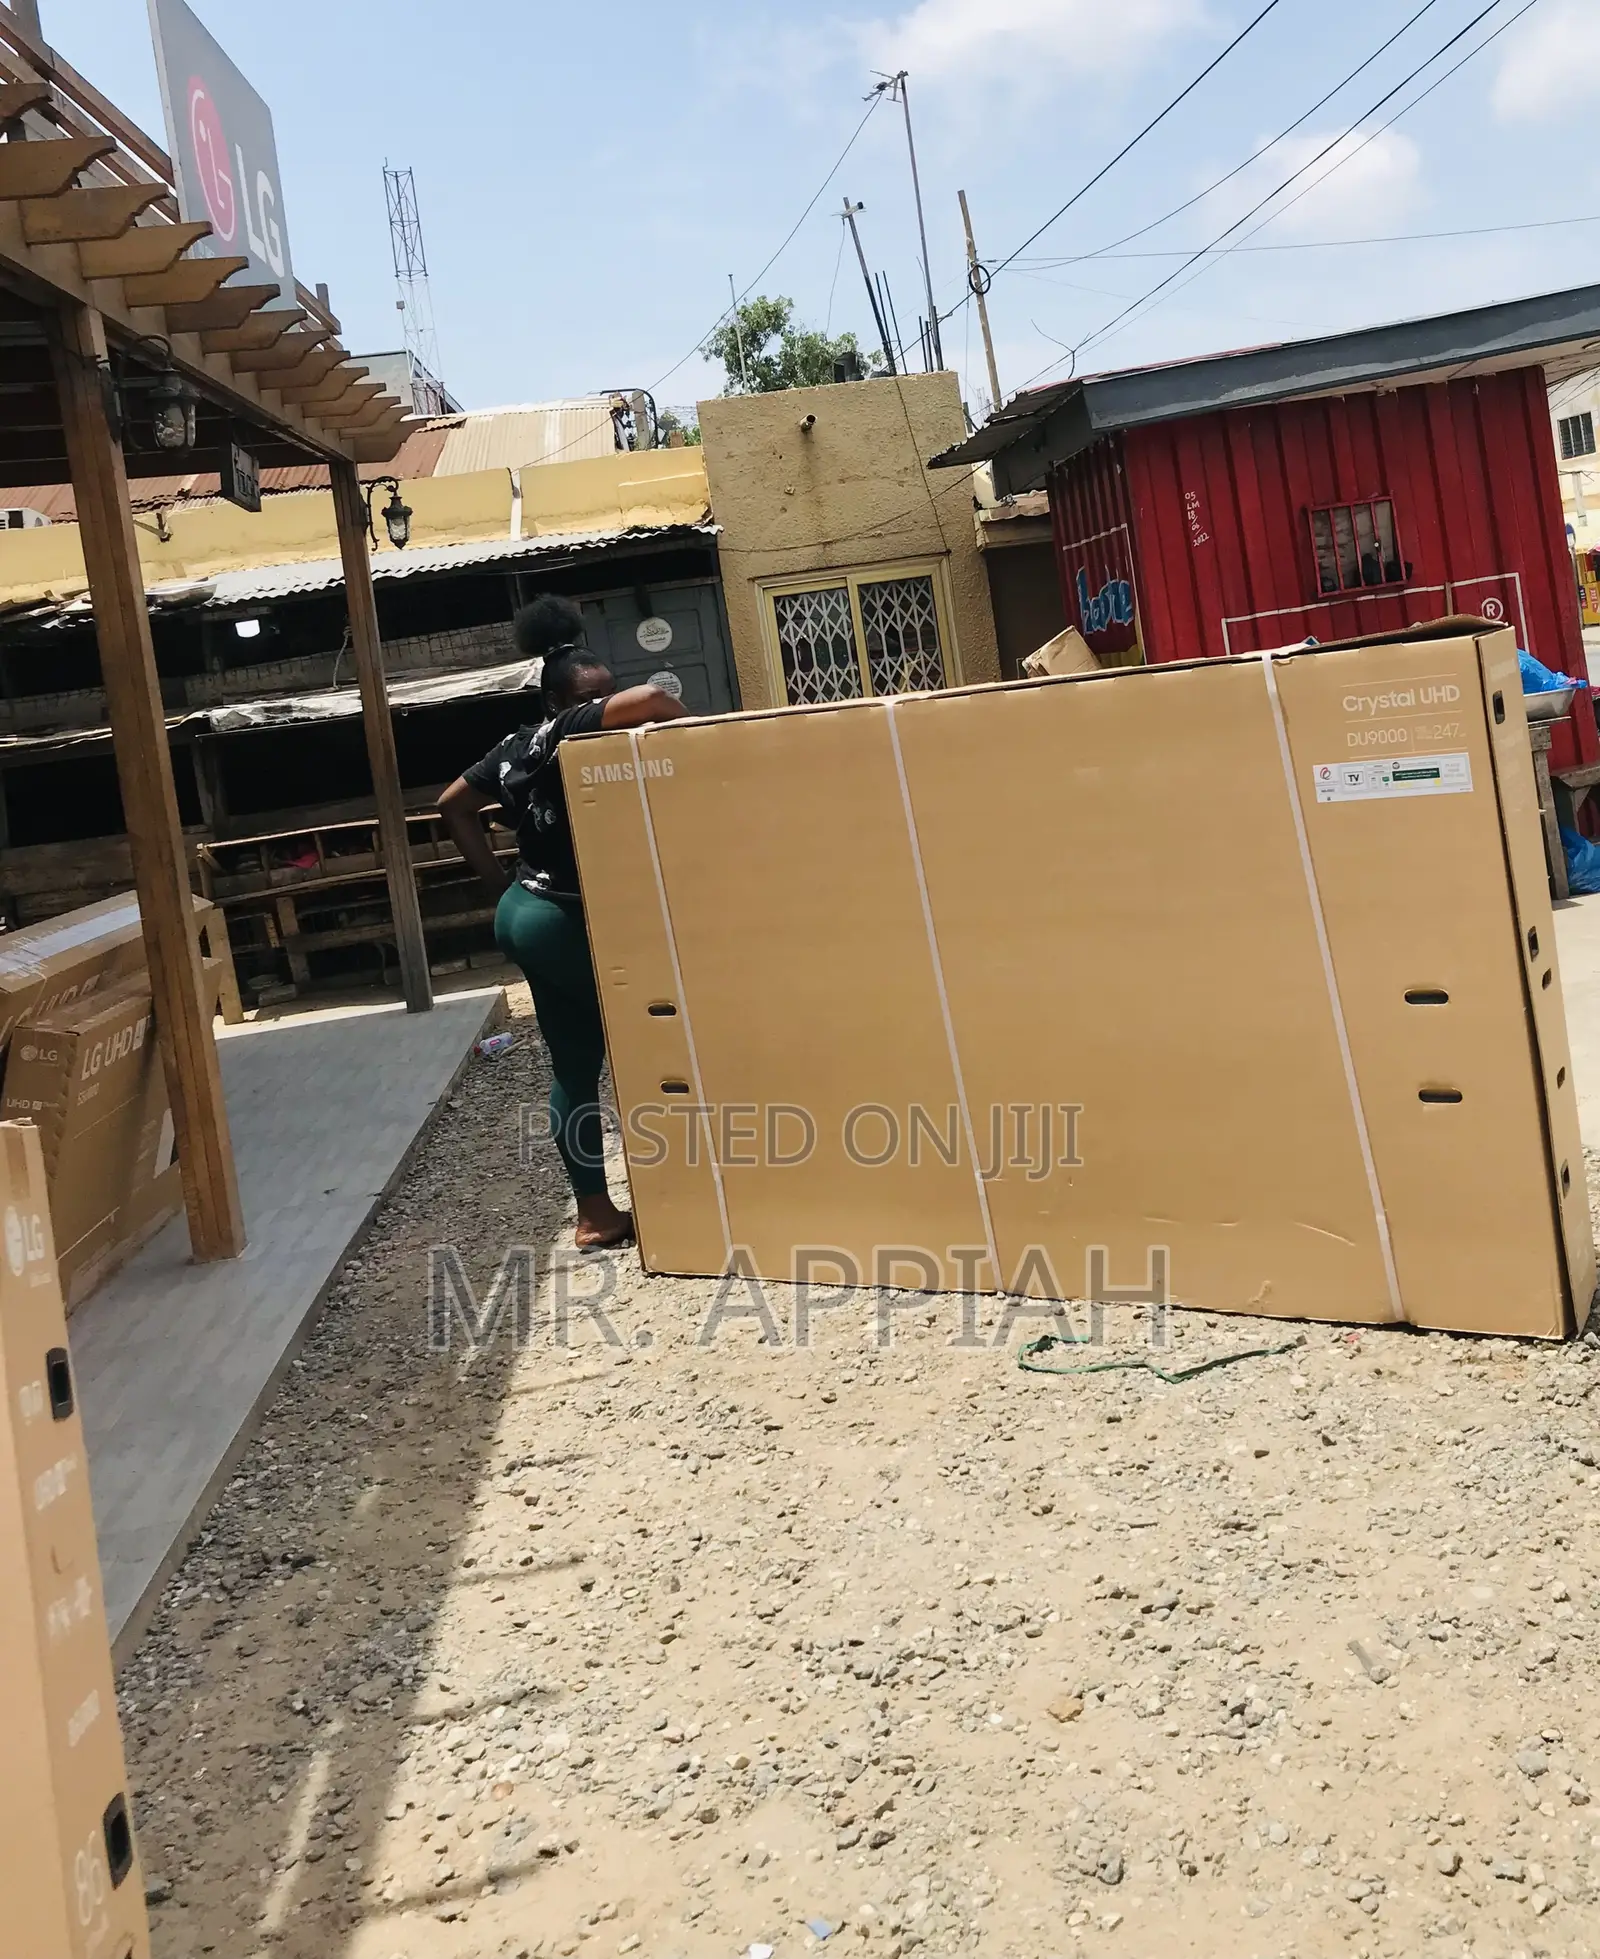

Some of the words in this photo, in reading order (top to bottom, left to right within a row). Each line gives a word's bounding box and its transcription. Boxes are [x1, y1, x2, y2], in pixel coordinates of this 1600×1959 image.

[235, 143, 285, 278] LG
[1187, 500, 1200, 510] LM
[1193, 532, 1210, 547] 2022
[1342, 688, 1416, 716] Crystal
[1420, 685, 1461, 704] UHD
[1347, 728, 1408, 747] DU9000
[1432, 723, 1460, 740] 247
[1348, 774, 1360, 782] TV
[39, 1048, 58, 1061] LG
[81, 1042, 104, 1081] LG
[104, 1025, 133, 1067] UHD
[6, 1098, 30, 1109] UHD
[22, 1213, 45, 1261] LG
